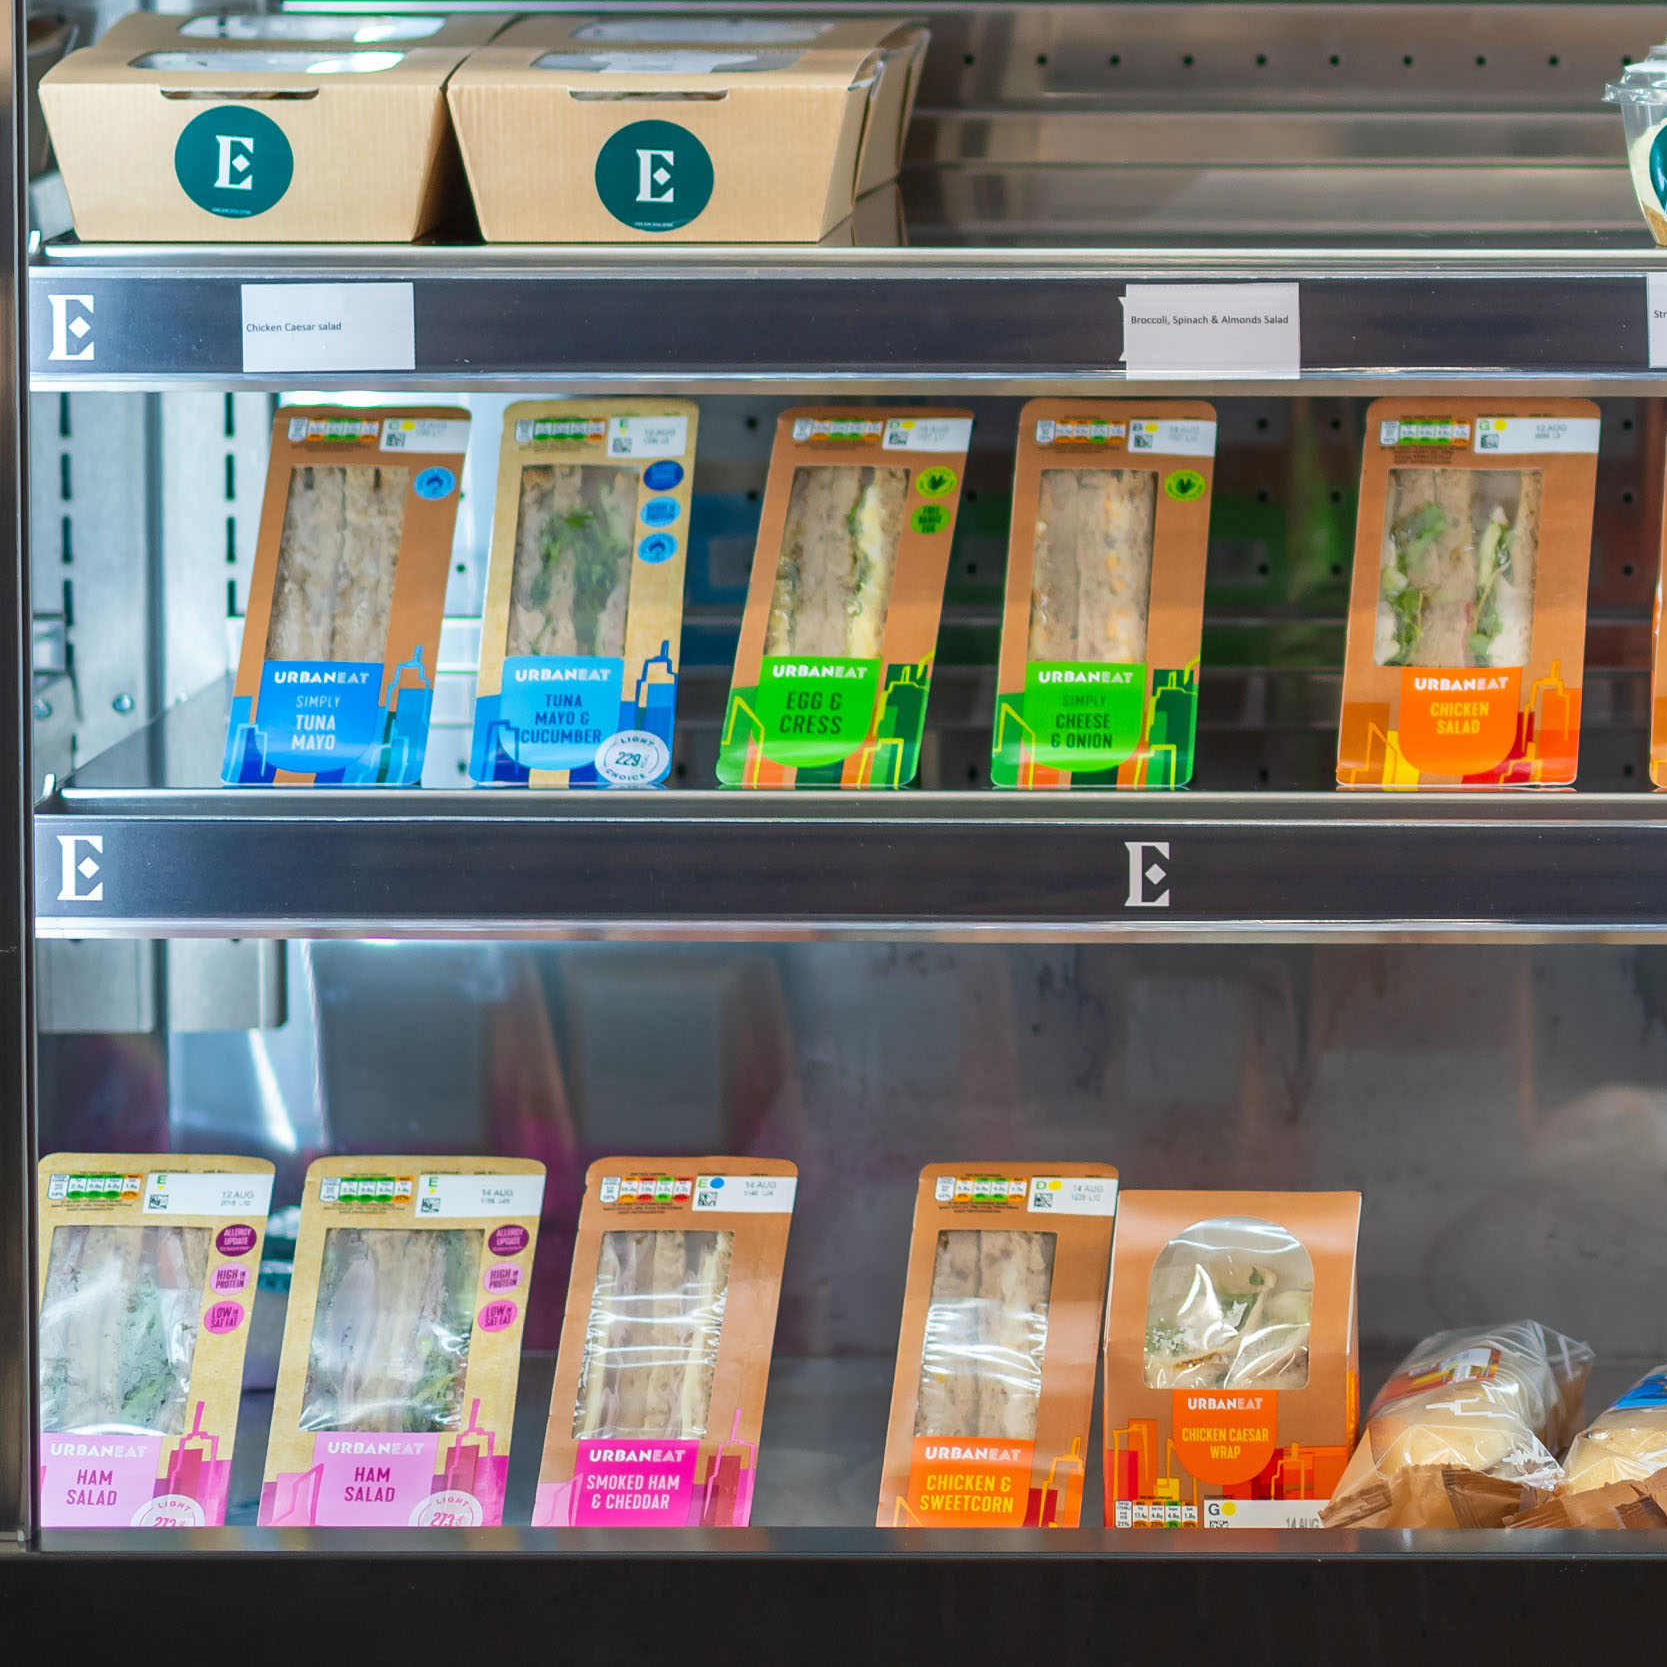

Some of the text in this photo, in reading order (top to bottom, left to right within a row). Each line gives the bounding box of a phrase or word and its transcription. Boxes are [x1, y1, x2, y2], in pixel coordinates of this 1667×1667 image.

[214, 134, 254, 190] E
[48, 294, 94, 360] E
[245, 321, 343, 333] Chicken Caesar salad
[1130, 314, 1290, 326] Broccoli, Spinach & Almonds Salad
[274, 672, 369, 684] URBANEAT
[773, 665, 868, 678] URBANEAT
[296, 695, 340, 708] SIMPLY
[786, 693, 825, 710] EGG
[296, 715, 335, 730] TUNA
[779, 717, 843, 734] CRESS
[292, 734, 334, 751] MAYO
[1124, 842, 1170, 907] E
[1187, 1398, 1263, 1410] URBANEAT
[1181, 1427, 1269, 1444] CHICKEN CAESAR
[328, 1442, 424, 1456] URBANEAT
[925, 1447, 1021, 1461] URBANEAT
[1210, 1445, 1241, 1459] WRAP
[355, 1467, 390, 1483] HAM
[927, 1475, 995, 1492] CHICKEN
[344, 1487, 395, 1503] SALAD
[436, 1497, 469, 1510] LIGHT
[919, 1494, 1014, 1513] SWEETCORN
